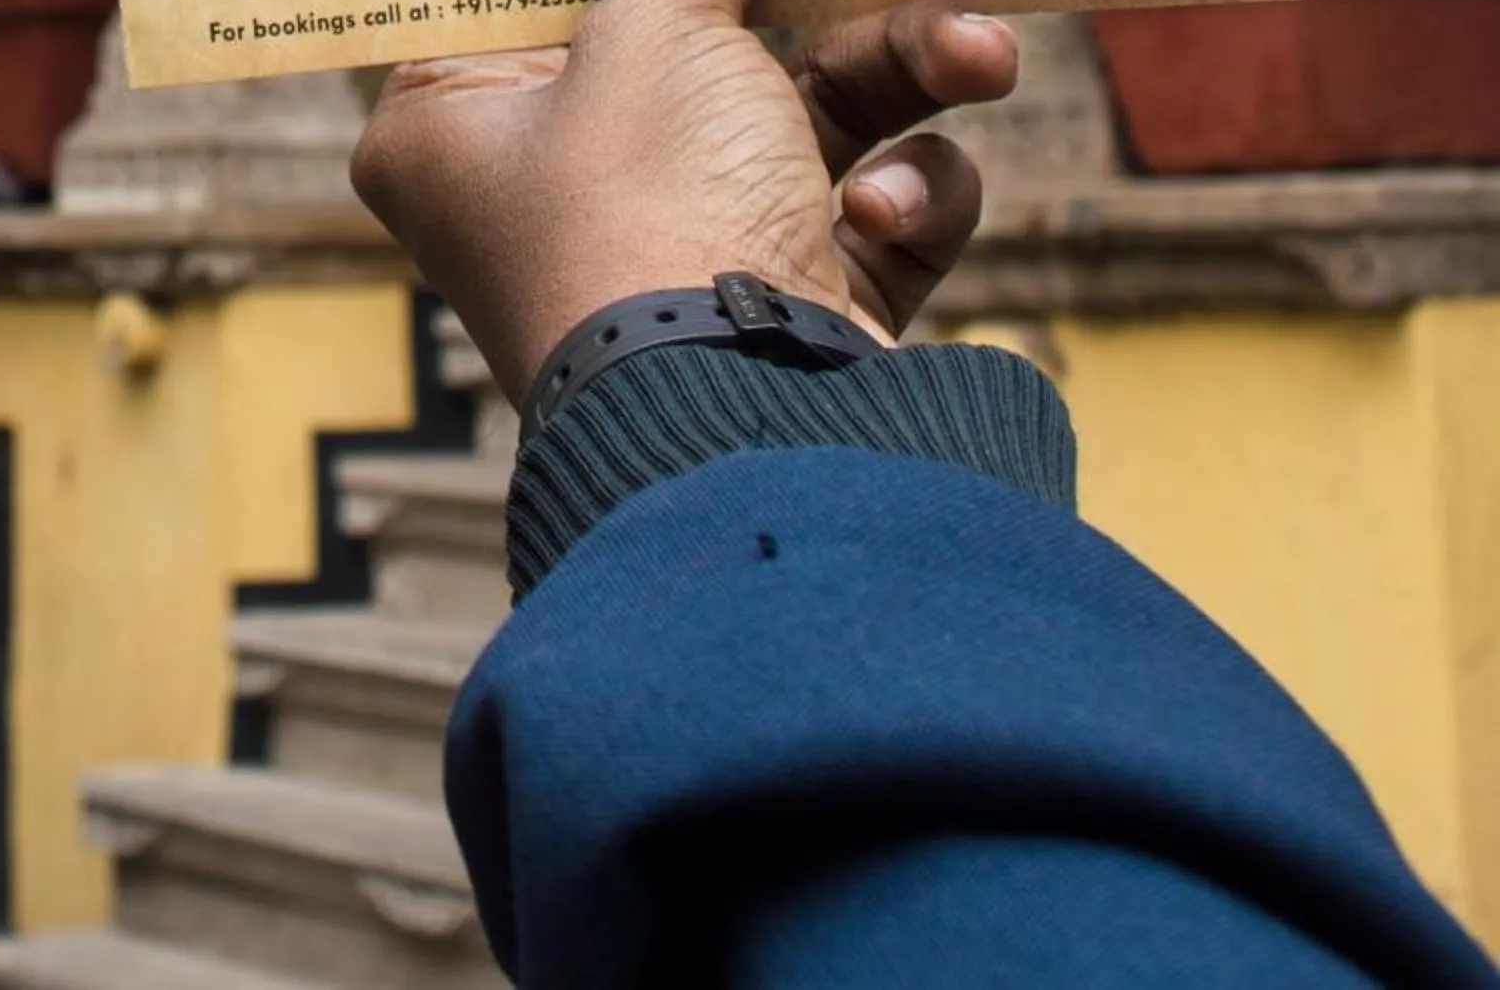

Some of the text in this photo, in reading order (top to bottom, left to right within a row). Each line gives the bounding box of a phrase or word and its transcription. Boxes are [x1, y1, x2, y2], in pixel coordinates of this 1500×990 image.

[209, 21, 245, 43] For
[252, 12, 356, 39] bookings
[363, 3, 401, 26] call
[409, 1, 430, 21] at
